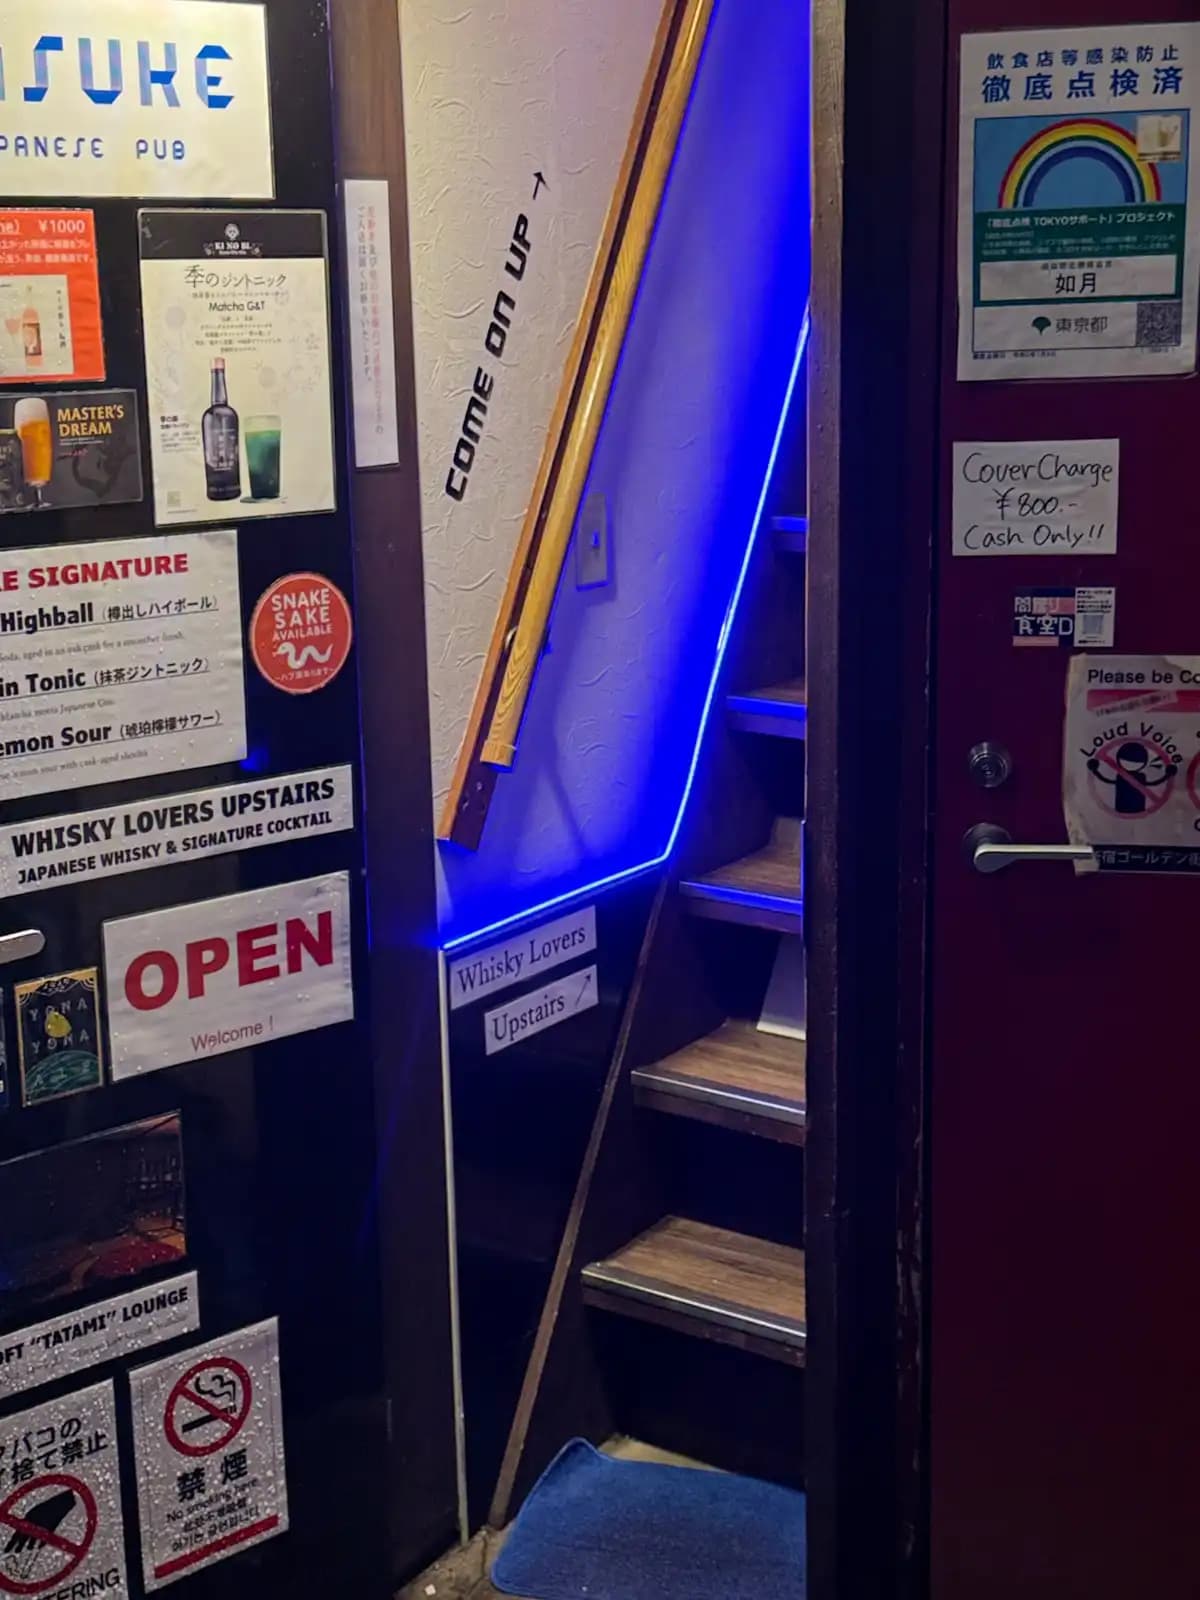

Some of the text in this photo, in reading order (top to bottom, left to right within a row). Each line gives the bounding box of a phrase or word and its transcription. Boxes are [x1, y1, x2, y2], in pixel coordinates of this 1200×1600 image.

[986, 44, 1179, 70] 飲食店等感染防止
[981, 66, 1183, 103] 徹底点検済
[136, 139, 186, 160] PUB
[38, 218, 86, 233] ¥1000
[184, 264, 287, 289] 季のジントニック
[1055, 271, 1097, 294] 如月
[208, 300, 266, 312] Matcha G&T
[1055, 316, 1108, 334] 東京都
[445, 213, 531, 502] COME ON UP
[57, 404, 125, 422] MASTER'S
[59, 422, 112, 437] DREAM
[962, 452, 1114, 488] Cover Charge
[963, 523, 1105, 550] Cash Only!!
[0, 553, 189, 592] E SIGNATURE
[271, 588, 331, 612] SNAKE
[1, 602, 94, 634] Highball
[274, 605, 330, 630] SAKE
[272, 623, 332, 642] AVAILABLE
[25, 669, 87, 693] Tonic
[1088, 669, 1145, 684] Please
[1151, 669, 1174, 684] be
[61, 725, 112, 745] Sour
[1080, 722, 1129, 757] Loud
[1140, 723, 1184, 764] Voice
[10, 778, 335, 858] WHISKY LOVERS UPSTAIRS
[17, 810, 333, 885] JAPANESE WHISKY & SIGNATURE COCKTAIL
[124, 910, 334, 1011] OPEN
[456, 926, 587, 993] Whisky Lovers
[492, 993, 566, 1041] Upstairs
[191, 1021, 263, 1053] Welcome
[0, 1342, 24, 1364] FT
[121, 1286, 189, 1322] LOUNGE
[0, 1430, 109, 1486] 捨て禁止
